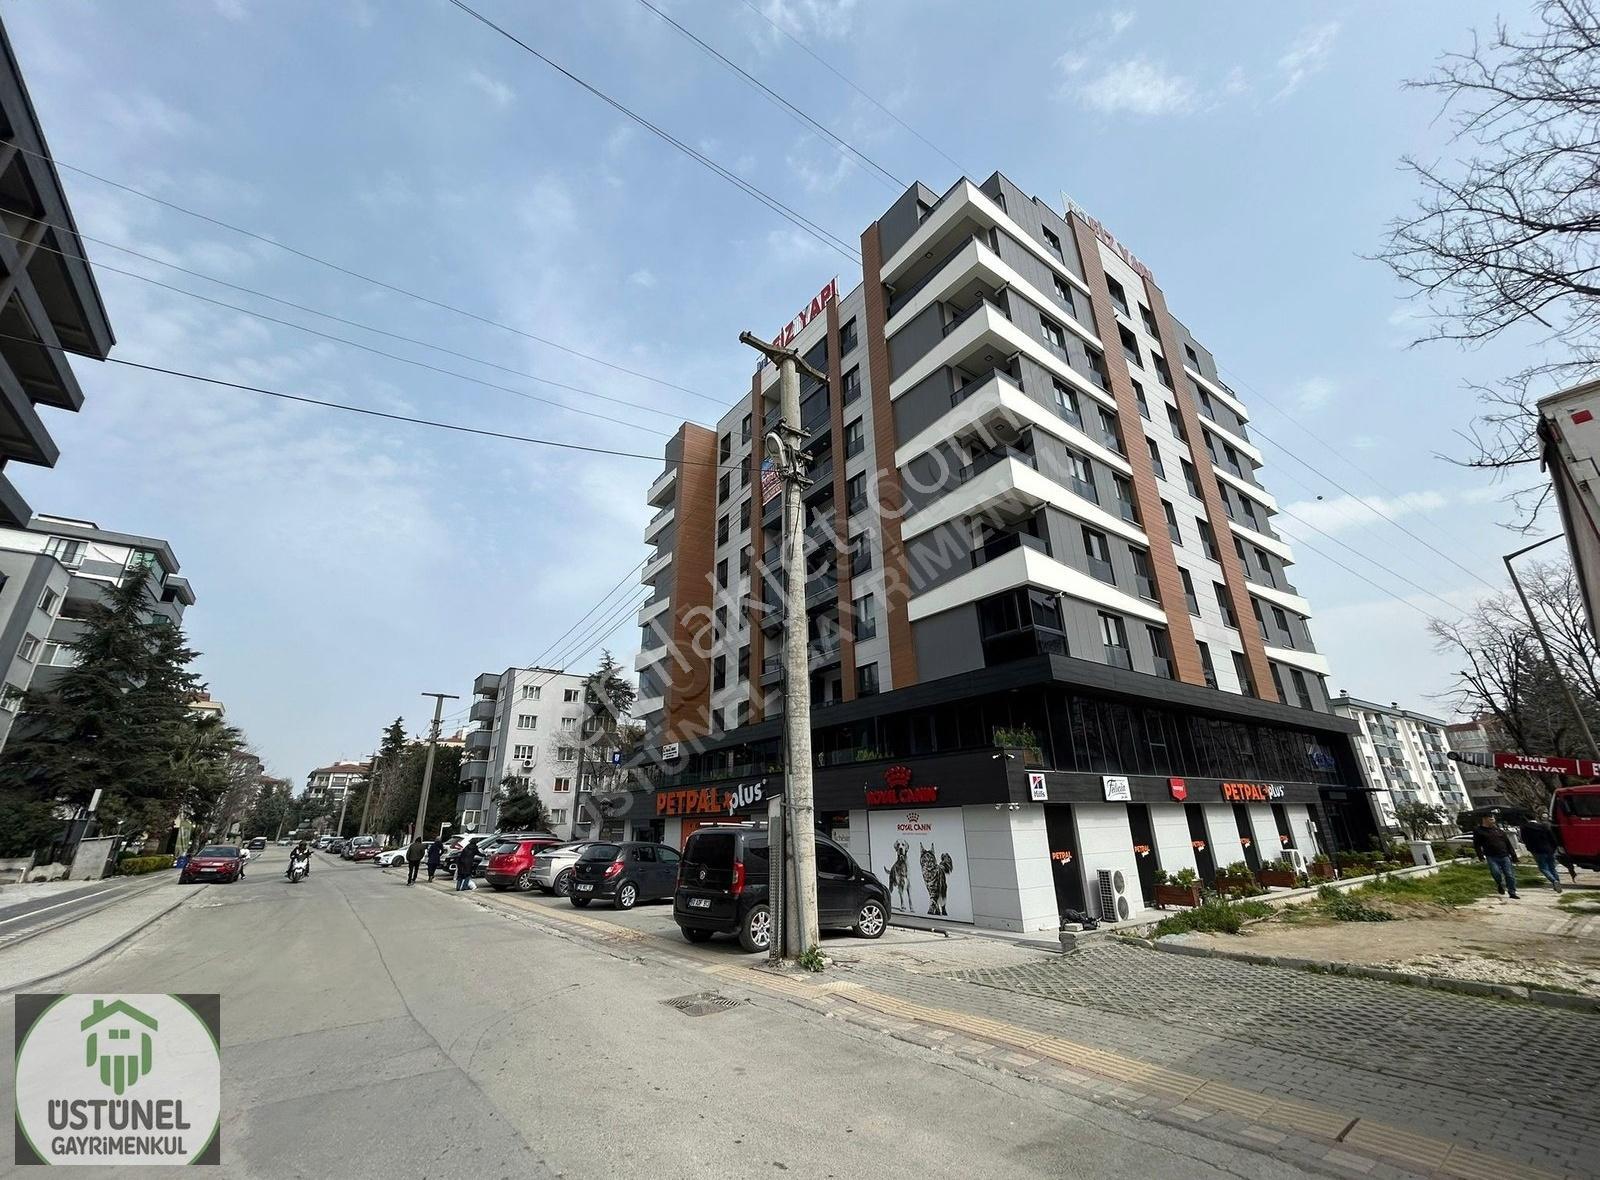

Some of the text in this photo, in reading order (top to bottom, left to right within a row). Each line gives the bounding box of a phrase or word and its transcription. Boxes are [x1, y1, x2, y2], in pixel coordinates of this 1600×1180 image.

[799, 278, 836, 329] YAPI
[1503, 763, 1567, 774] NAKLİYAT
[1592, 762, 1600, 776] E
[1223, 783, 1266, 800] PETPAL
[656, 782, 763, 816] PETPAL plus
[897, 823, 932, 832] ROYAL CANIN
[1051, 851, 1073, 860] PETPAL
